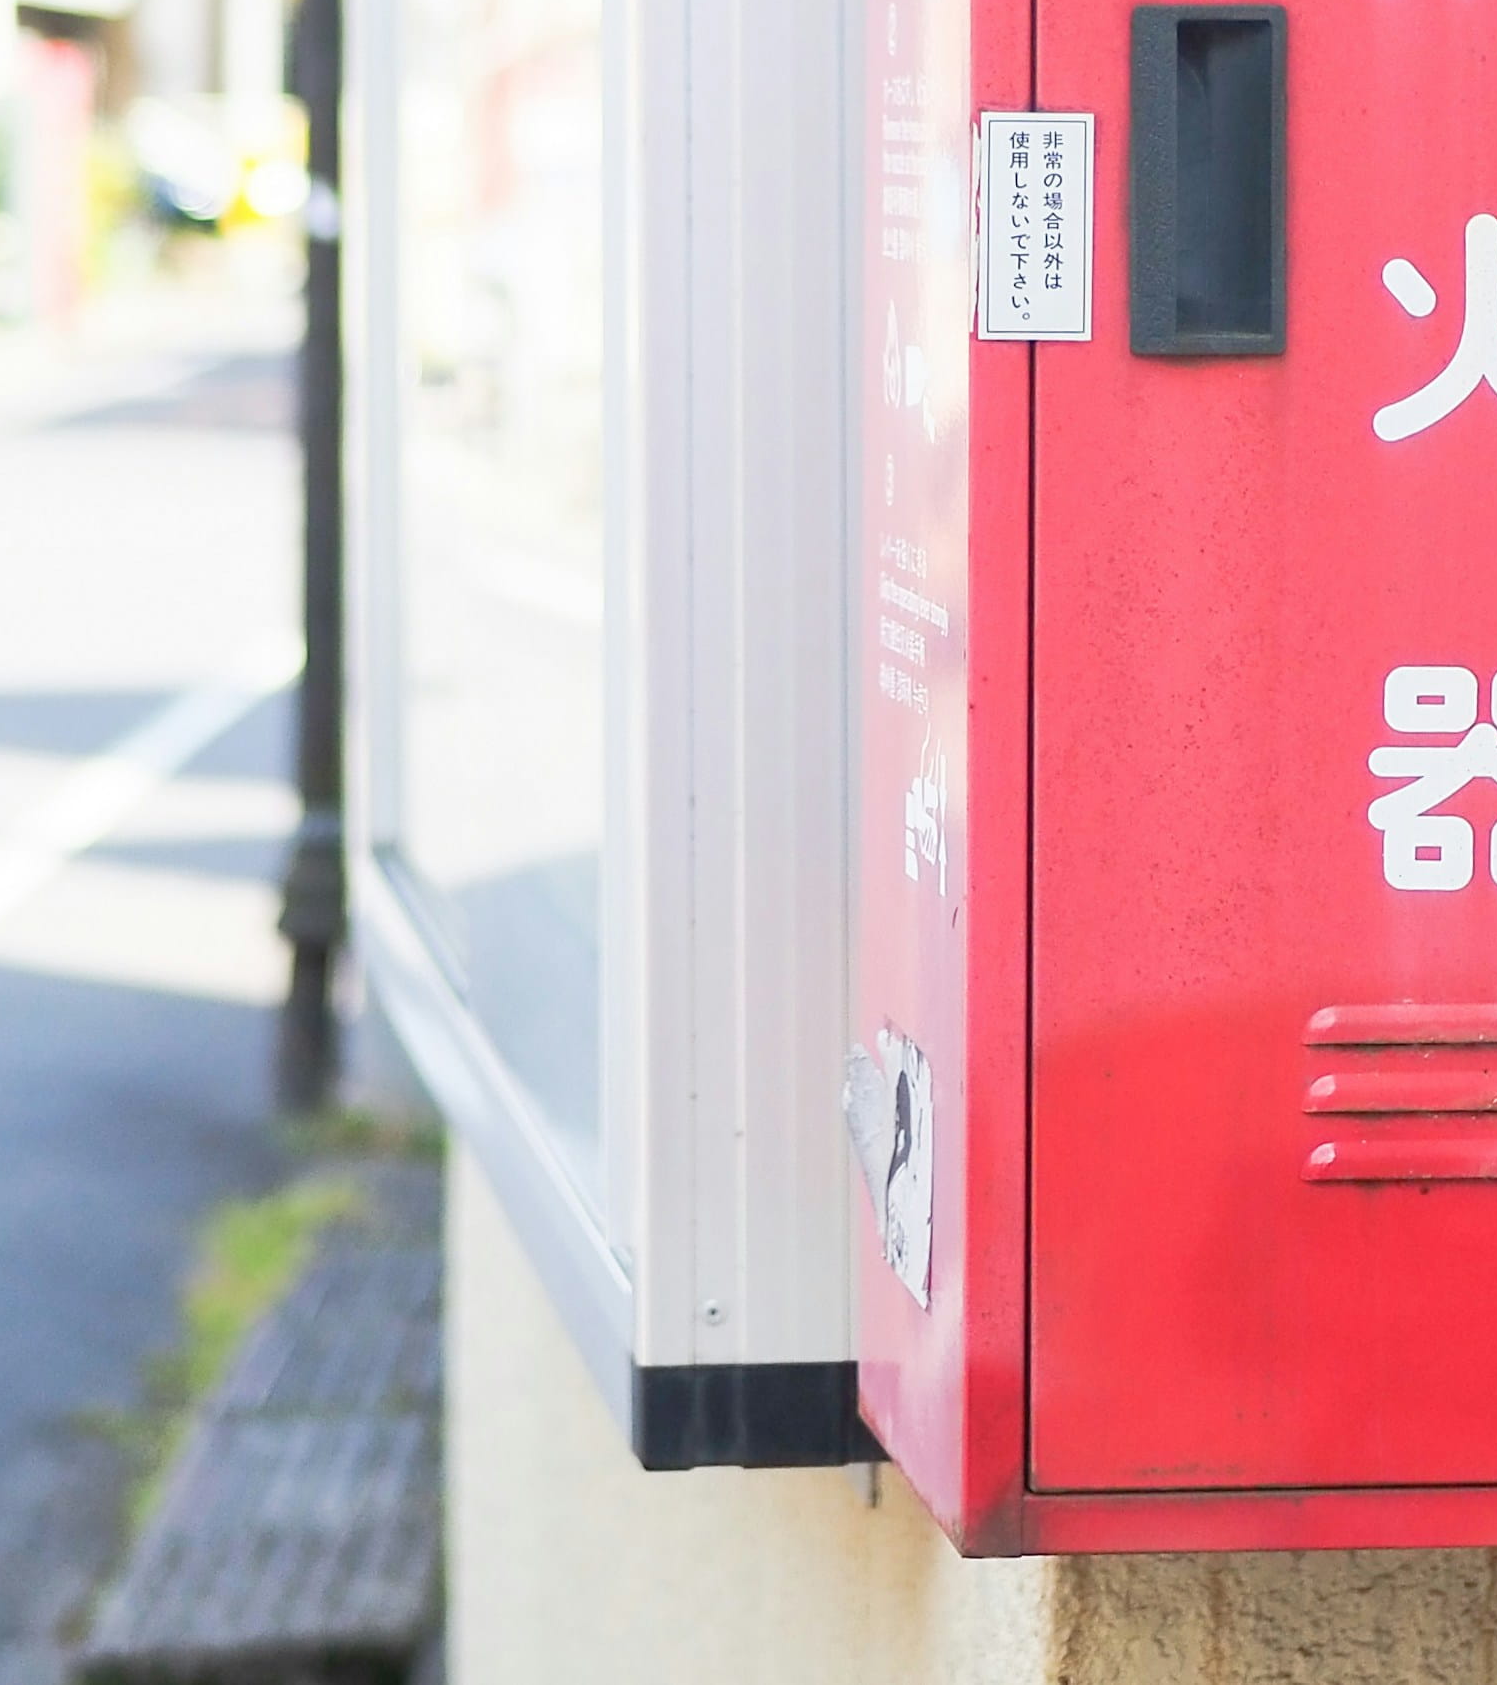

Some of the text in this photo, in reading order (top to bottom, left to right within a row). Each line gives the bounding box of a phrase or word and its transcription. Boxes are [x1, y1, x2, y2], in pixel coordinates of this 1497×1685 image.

[1009, 131, 1031, 321] 使用しないで下さい。
[1042, 131, 1065, 290] 非常の場合以外は
